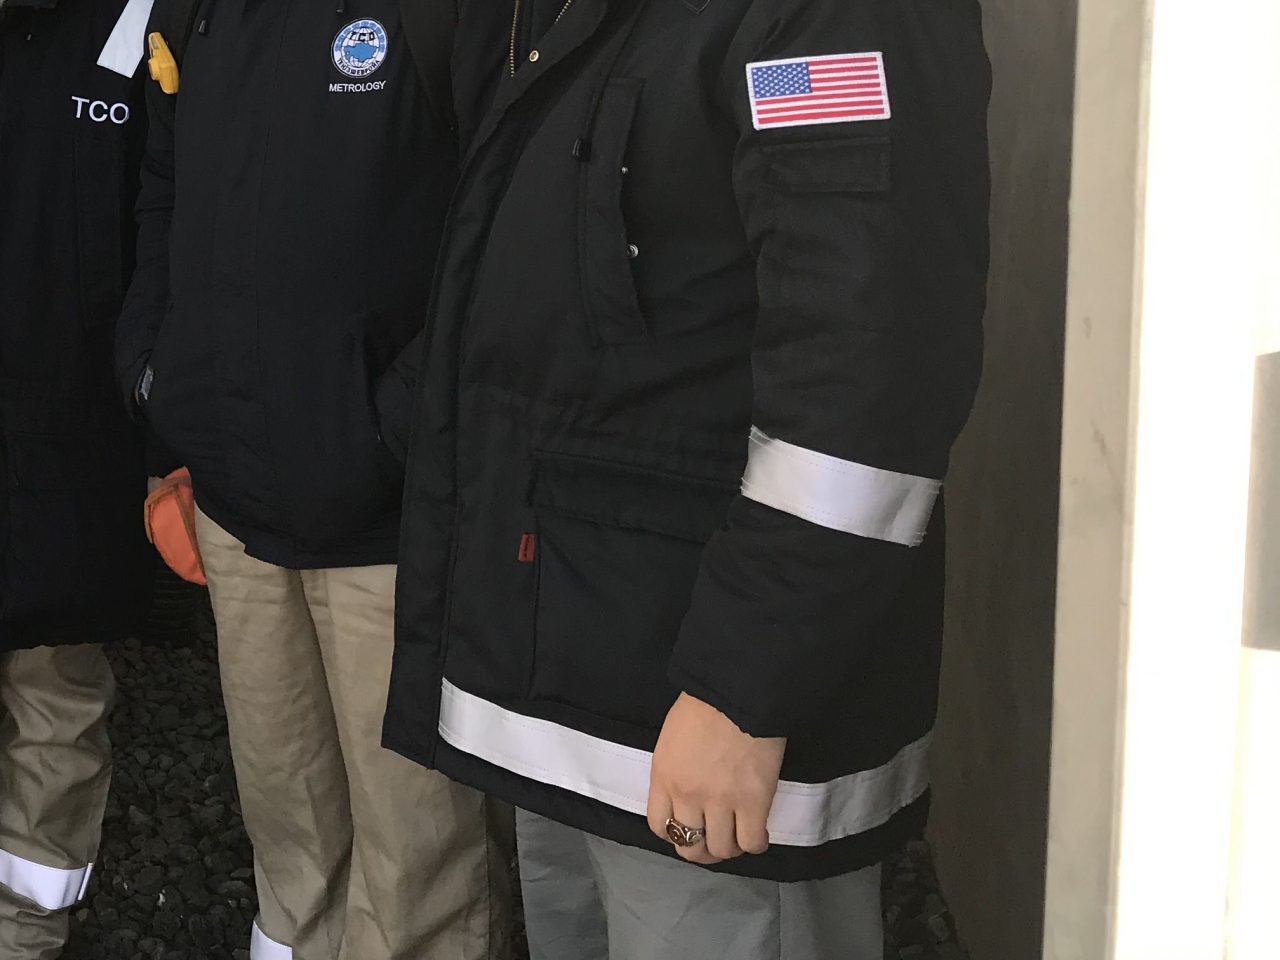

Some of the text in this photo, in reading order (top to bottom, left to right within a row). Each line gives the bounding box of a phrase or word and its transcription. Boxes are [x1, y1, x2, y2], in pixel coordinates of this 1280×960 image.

[350, 31, 375, 43] TCO
[328, 80, 387, 93] METROLOGY
[71, 95, 130, 125] TCO
